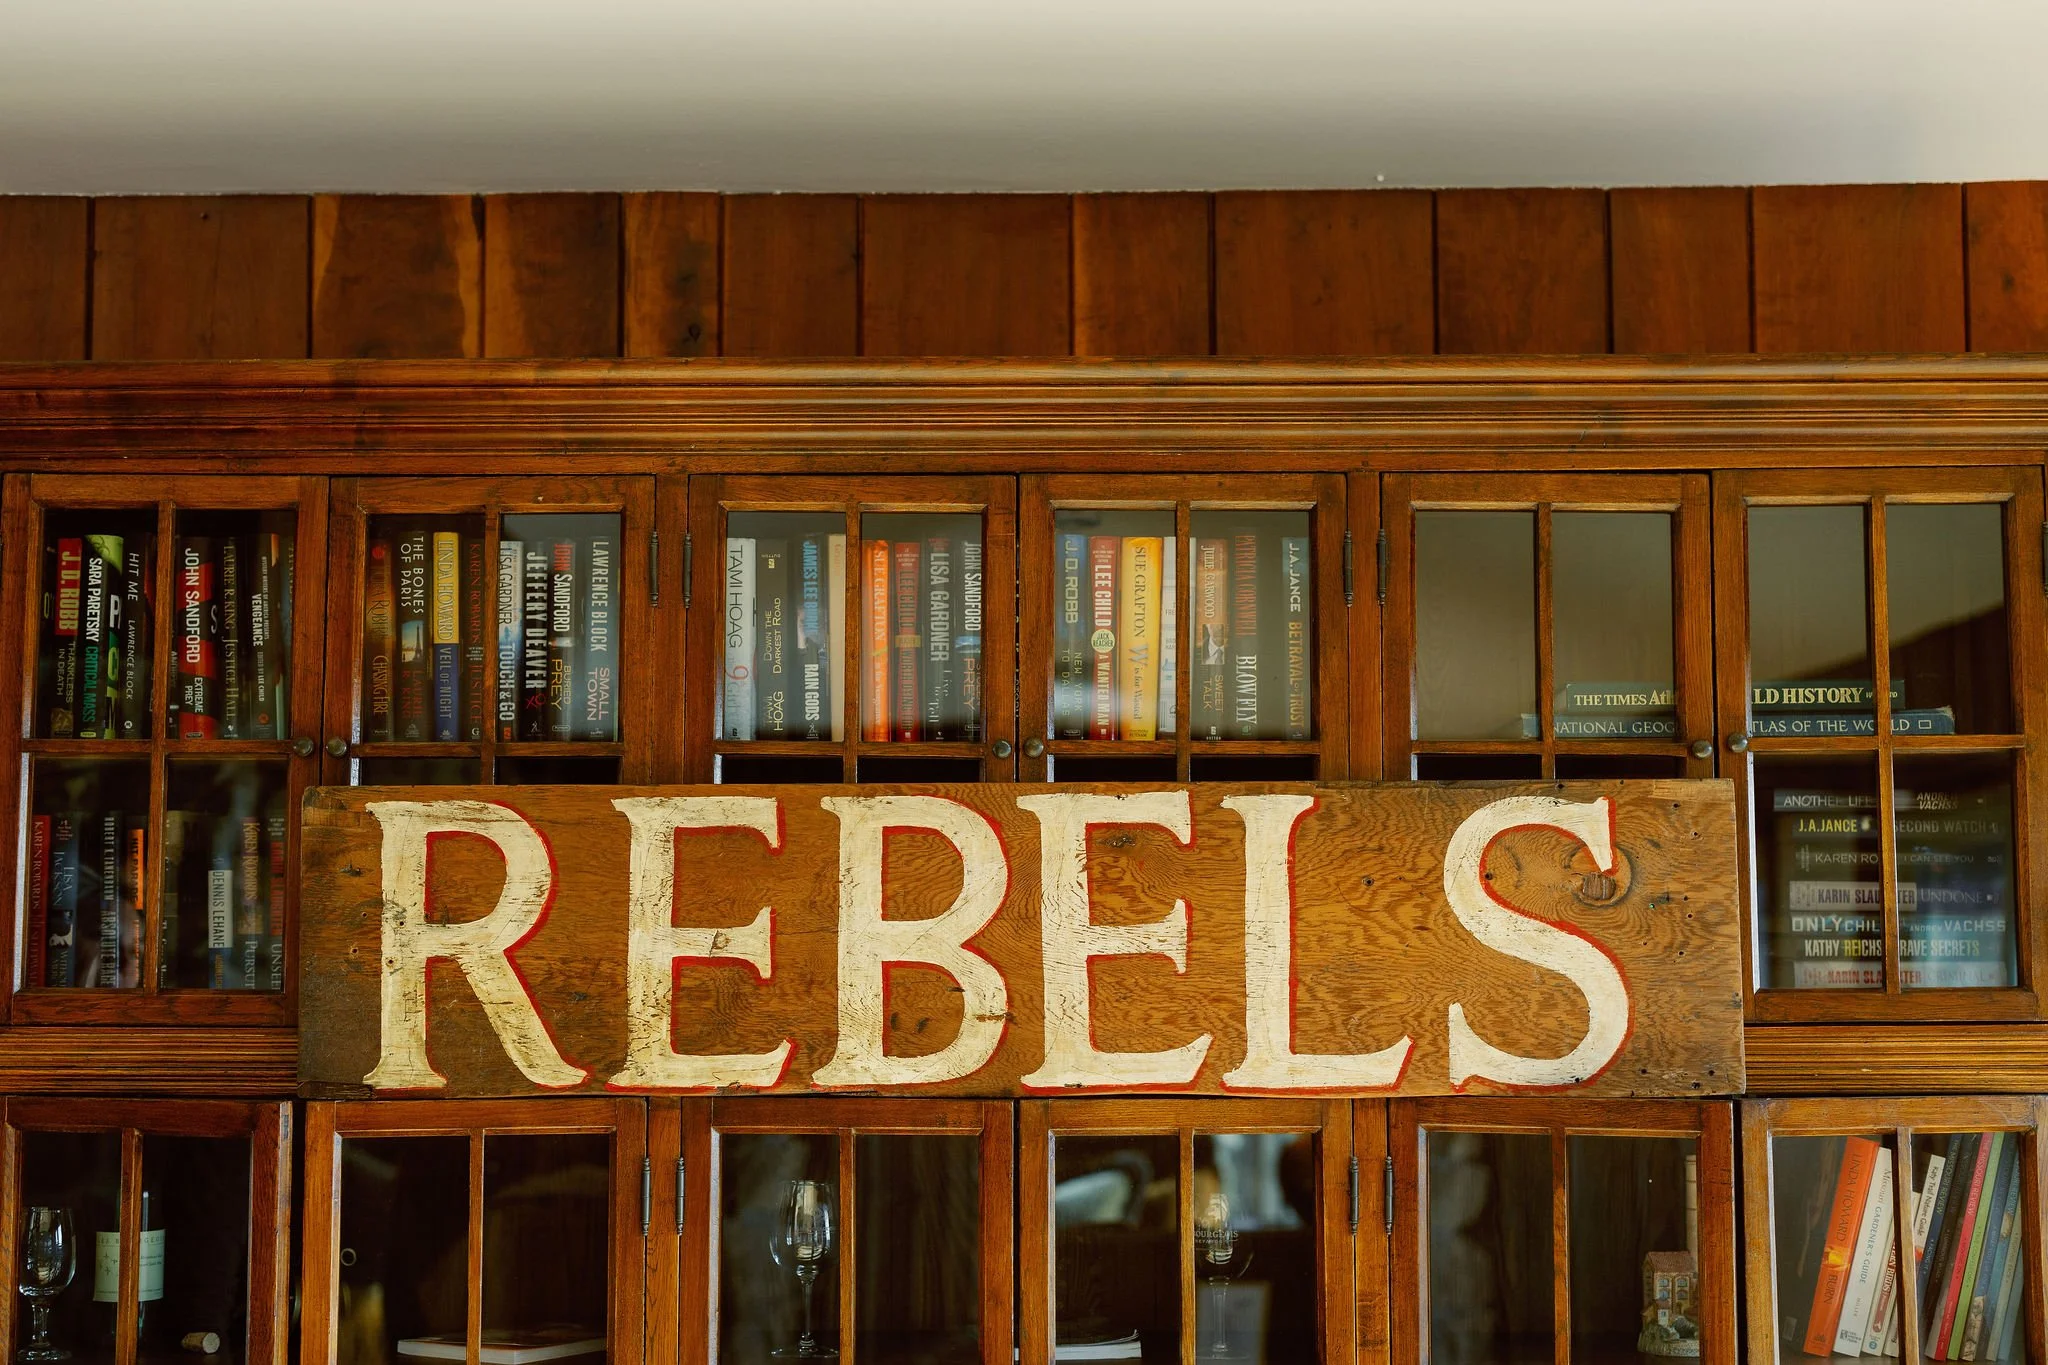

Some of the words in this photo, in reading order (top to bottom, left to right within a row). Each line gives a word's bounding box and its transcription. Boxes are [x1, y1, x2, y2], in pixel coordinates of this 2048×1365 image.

[61, 551, 81, 565] J.
[401, 543, 411, 563] OF
[413, 536, 424, 560] THE
[437, 541, 453, 579] LINDA
[499, 548, 513, 572] LISA
[554, 543, 571, 571] JOHN
[803, 541, 818, 579] JAMES
[964, 542, 981, 570] JOHN
[1065, 541, 1078, 553] J.
[1134, 547, 1145, 574] SUE
[1201, 545, 1215, 569] JULIE
[61, 570, 80, 584] D.
[88, 558, 102, 584] SARA
[128, 552, 139, 576] HIT
[184, 548, 199, 585] JOHN
[223, 545, 236, 585] LAURIE
[469, 544, 481, 586] KAREN
[591, 541, 609, 607] LAWRENCE
[728, 545, 743, 588] TAMI
[874, 551, 886, 576] SUE
[930, 553, 949, 584] LISA
[1065, 558, 1078, 572] D.
[1095, 565, 1111, 587] LEE
[127, 581, 138, 601] ME
[224, 589, 235, 599] R.
[401, 571, 411, 607] PARIS
[413, 568, 424, 614] BONES
[526, 552, 547, 621] JEFFERY
[804, 582, 818, 599] LEE
[900, 570, 914, 590] LEE
[1204, 573, 1215, 618] GARWOOD
[58, 588, 80, 630] ROBB
[85, 588, 101, 642] PARETSKY
[224, 601, 235, 629] KING
[437, 584, 454, 640] HOWARD
[499, 574, 513, 625] GARDNER
[553, 574, 572, 632] SANDFORD
[772, 598, 781, 625] ROAD
[874, 578, 885, 640] GRAFTON
[900, 594, 915, 628] CHILD
[965, 573, 981, 630] SANDFORD
[1065, 576, 1078, 623] ROBB
[1095, 591, 1111, 626] CHILD
[1134, 574, 1146, 638] GRAFTON
[186, 591, 200, 663] SANDFORD
[251, 594, 263, 646] VENGEANCE
[469, 591, 482, 643] ROBARDS
[590, 611, 607, 652] BLOCK
[729, 592, 743, 648] HOAG
[930, 591, 950, 661] GARDNER
[58, 648, 65, 658] IN
[127, 620, 135, 667] LAWRENCE
[439, 647, 451, 670] VEIL
[526, 628, 546, 689] DEAVER
[773, 630, 781, 674] DARKEST
[1062, 649, 1070, 663] TO
[1129, 644, 1148, 666] W
[1289, 622, 1303, 685] BETRAYAL
[65, 641, 76, 703] THANKLESS
[84, 646, 99, 690] CRITICAL
[221, 636, 238, 684] JUSTICE
[499, 643, 515, 687] TOUCH
[1074, 652, 1082, 674] NEW
[1135, 667, 1141, 675] is
[1236, 655, 1257, 695] BLOW
[56, 660, 65, 696] DEATH
[126, 671, 134, 700] BLOCK
[439, 673, 448, 684] OF
[551, 659, 561, 710] PREY
[805, 664, 819, 690] RAIN
[964, 658, 975, 710] PREY
[1097, 662, 1108, 700] WANTED
[1133, 676, 1141, 687] for
[82, 693, 98, 722] MASS
[184, 686, 193, 705] PREY
[194, 677, 203, 713] EXTREME
[225, 688, 239, 720] HALL
[440, 687, 451, 719] NIGHT
[499, 691, 511, 699] &
[587, 668, 598, 720] TOWN
[598, 667, 609, 720] SMALL
[805, 692, 820, 721] GODS
[1074, 683, 1082, 712] YORK
[1134, 690, 1142, 720] Wasted
[1203, 679, 1212, 709] TALK
[1215, 675, 1223, 712] SWEET
[1574, 695, 1602, 705] THE
[1604, 695, 1647, 705] TIMES
[1782, 687, 1865, 704] HISTORY
[499, 702, 515, 721] GO
[773, 691, 784, 731] HOAG
[1097, 704, 1108, 725] MAN
[1236, 698, 1257, 724] FLY
[1290, 692, 1304, 727] TRUST
[1792, 721, 1811, 732] OF
[1817, 720, 1848, 732] THE
[33, 822, 44, 858] KAREN
[243, 822, 260, 853] KAREN
[1944, 821, 1987, 833] WATCH
[1816, 853, 1857, 864] KAREN
[32, 861, 43, 909] ROBARDS
[63, 867, 75, 891] LISA
[212, 872, 225, 907] DENNIS
[243, 856, 258, 900] ROBARDS
[1818, 889, 1850, 903] KARIN
[1920, 890, 1985, 904] UNDONE
[212, 910, 224, 947] LEHANE
[1792, 917, 1842, 932] ONLY
[1944, 920, 2006, 932] VACHSS
[363, 791, 1631, 1091] REBELS
[1805, 939, 1840, 957] KATHY
[1844, 939, 1882, 957] REICHS
[1900, 939, 1927, 957] RAVE
[1931, 939, 1980, 957] SECRETS
[1847, 1154, 1861, 1186] LINDA
[1930, 1166, 1940, 1180] Katy
[1942, 1152, 1956, 1186] MISSOURI
[1971, 1153, 1988, 1187] MISSOURI
[1877, 1169, 1892, 1203] Missouri
[1928, 1182, 1937, 1196] Trail
[1936, 1187, 1948, 1216] REVIEW
[1966, 1187, 1979, 1216] REVIEW
[1836, 1189, 1855, 1242] HOWARD
[1921, 1196, 1932, 1217] Nature
[1865, 1206, 1882, 1256] GARDENER'S
[1917, 1218, 1927, 1236] Guide
[1859, 1259, 1870, 1283] GUIDE
[1882, 1268, 1896, 1292] BIRDS
[1823, 1274, 1838, 1304] BURN
